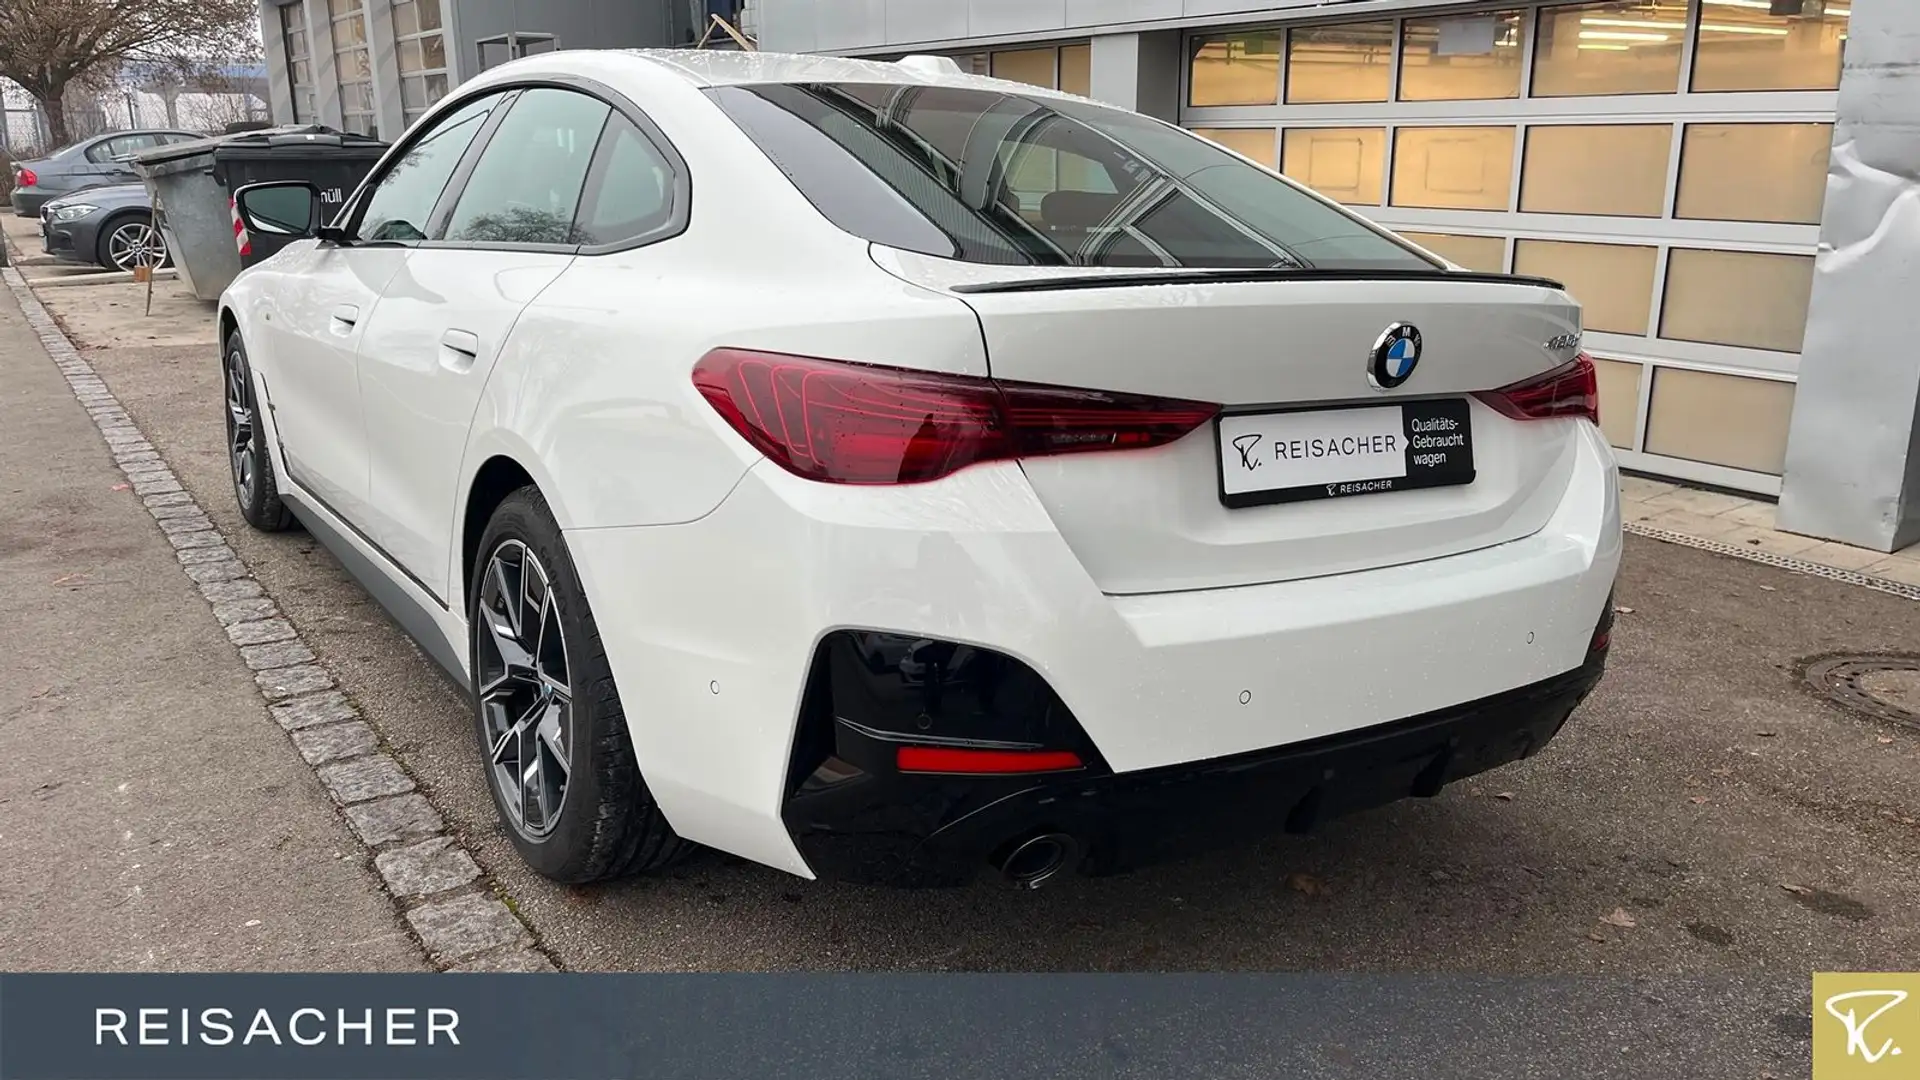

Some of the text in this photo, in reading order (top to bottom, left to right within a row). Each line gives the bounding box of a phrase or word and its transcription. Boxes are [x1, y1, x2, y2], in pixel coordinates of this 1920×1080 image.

[1411, 417, 1459, 432] Qualitäts-
[1275, 435, 1396, 460] REISACHER
[1412, 433, 1464, 449] Gebraucht
[1413, 453, 1447, 467] wagen
[1340, 480, 1392, 494] REISACHER
